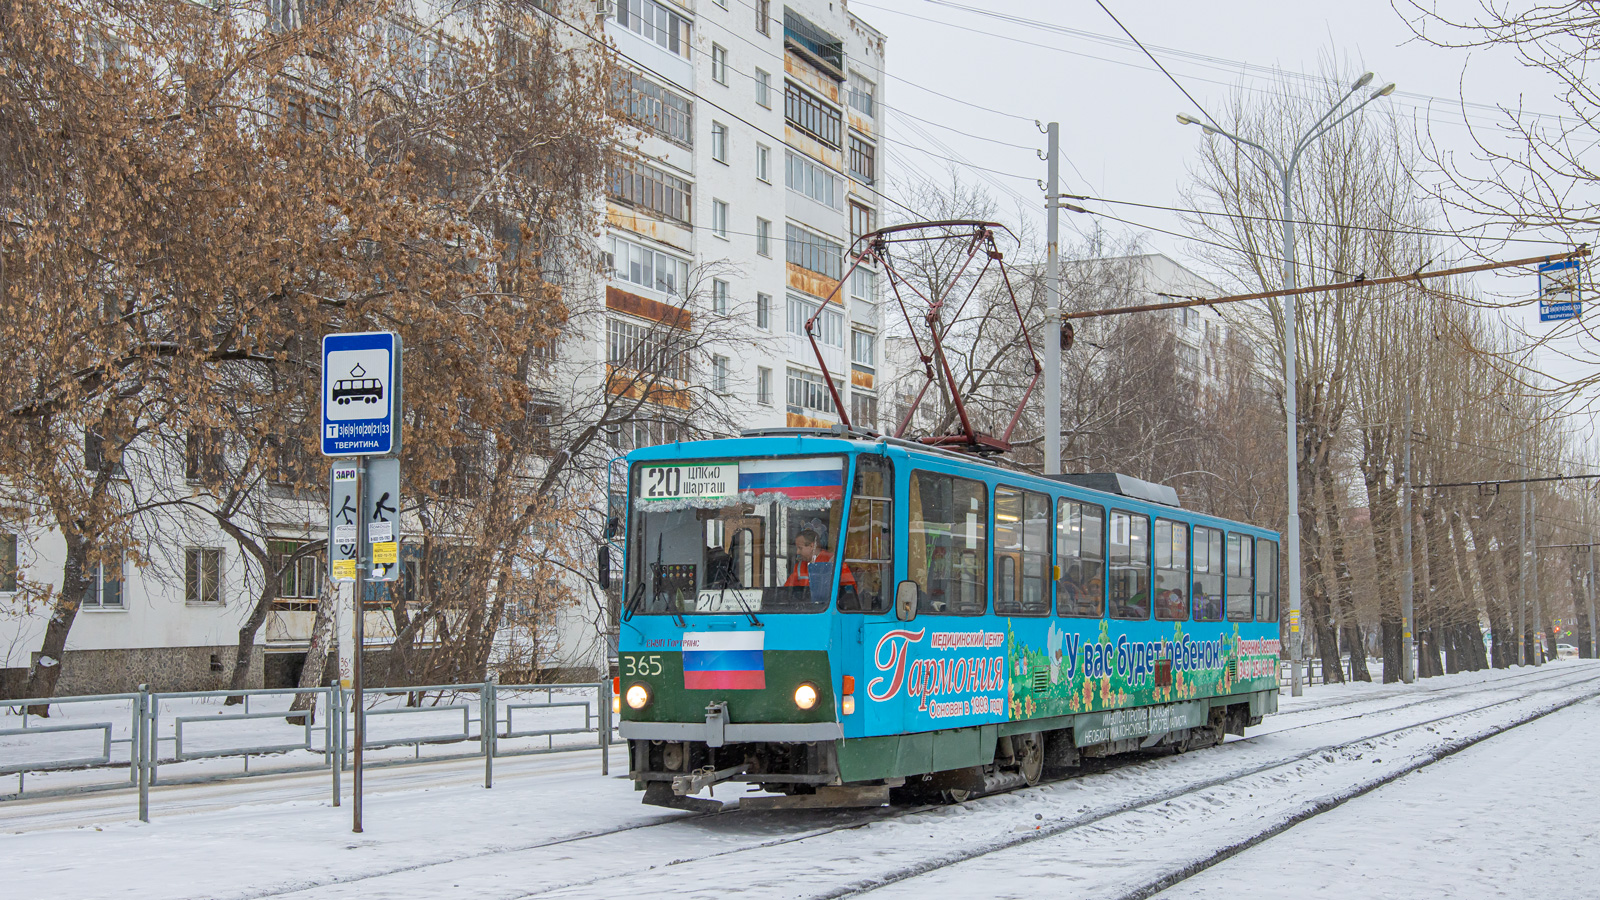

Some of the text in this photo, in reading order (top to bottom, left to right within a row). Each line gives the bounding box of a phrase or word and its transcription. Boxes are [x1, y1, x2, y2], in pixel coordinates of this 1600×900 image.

[334, 440, 380, 449] ТВЕРИТИНА
[648, 467, 681, 497] 20
[688, 466, 720, 480] ЦПКиО
[683, 482, 725, 496] Шарташ
[698, 592, 722, 612] 20
[930, 629, 1004, 651] МЕДИЦИНСКИЙ ЦЕНТР
[1237, 635, 1260, 656] Лечение
[624, 655, 662, 676] 365
[867, 626, 1004, 711] Гармония
[1066, 632, 1224, 686] У вас будет ребенок!
[1237, 655, 1252, 683] (343)
[1252, 659, 1261, 678] 254
[929, 695, 1004, 719] Основан в 1993 году
